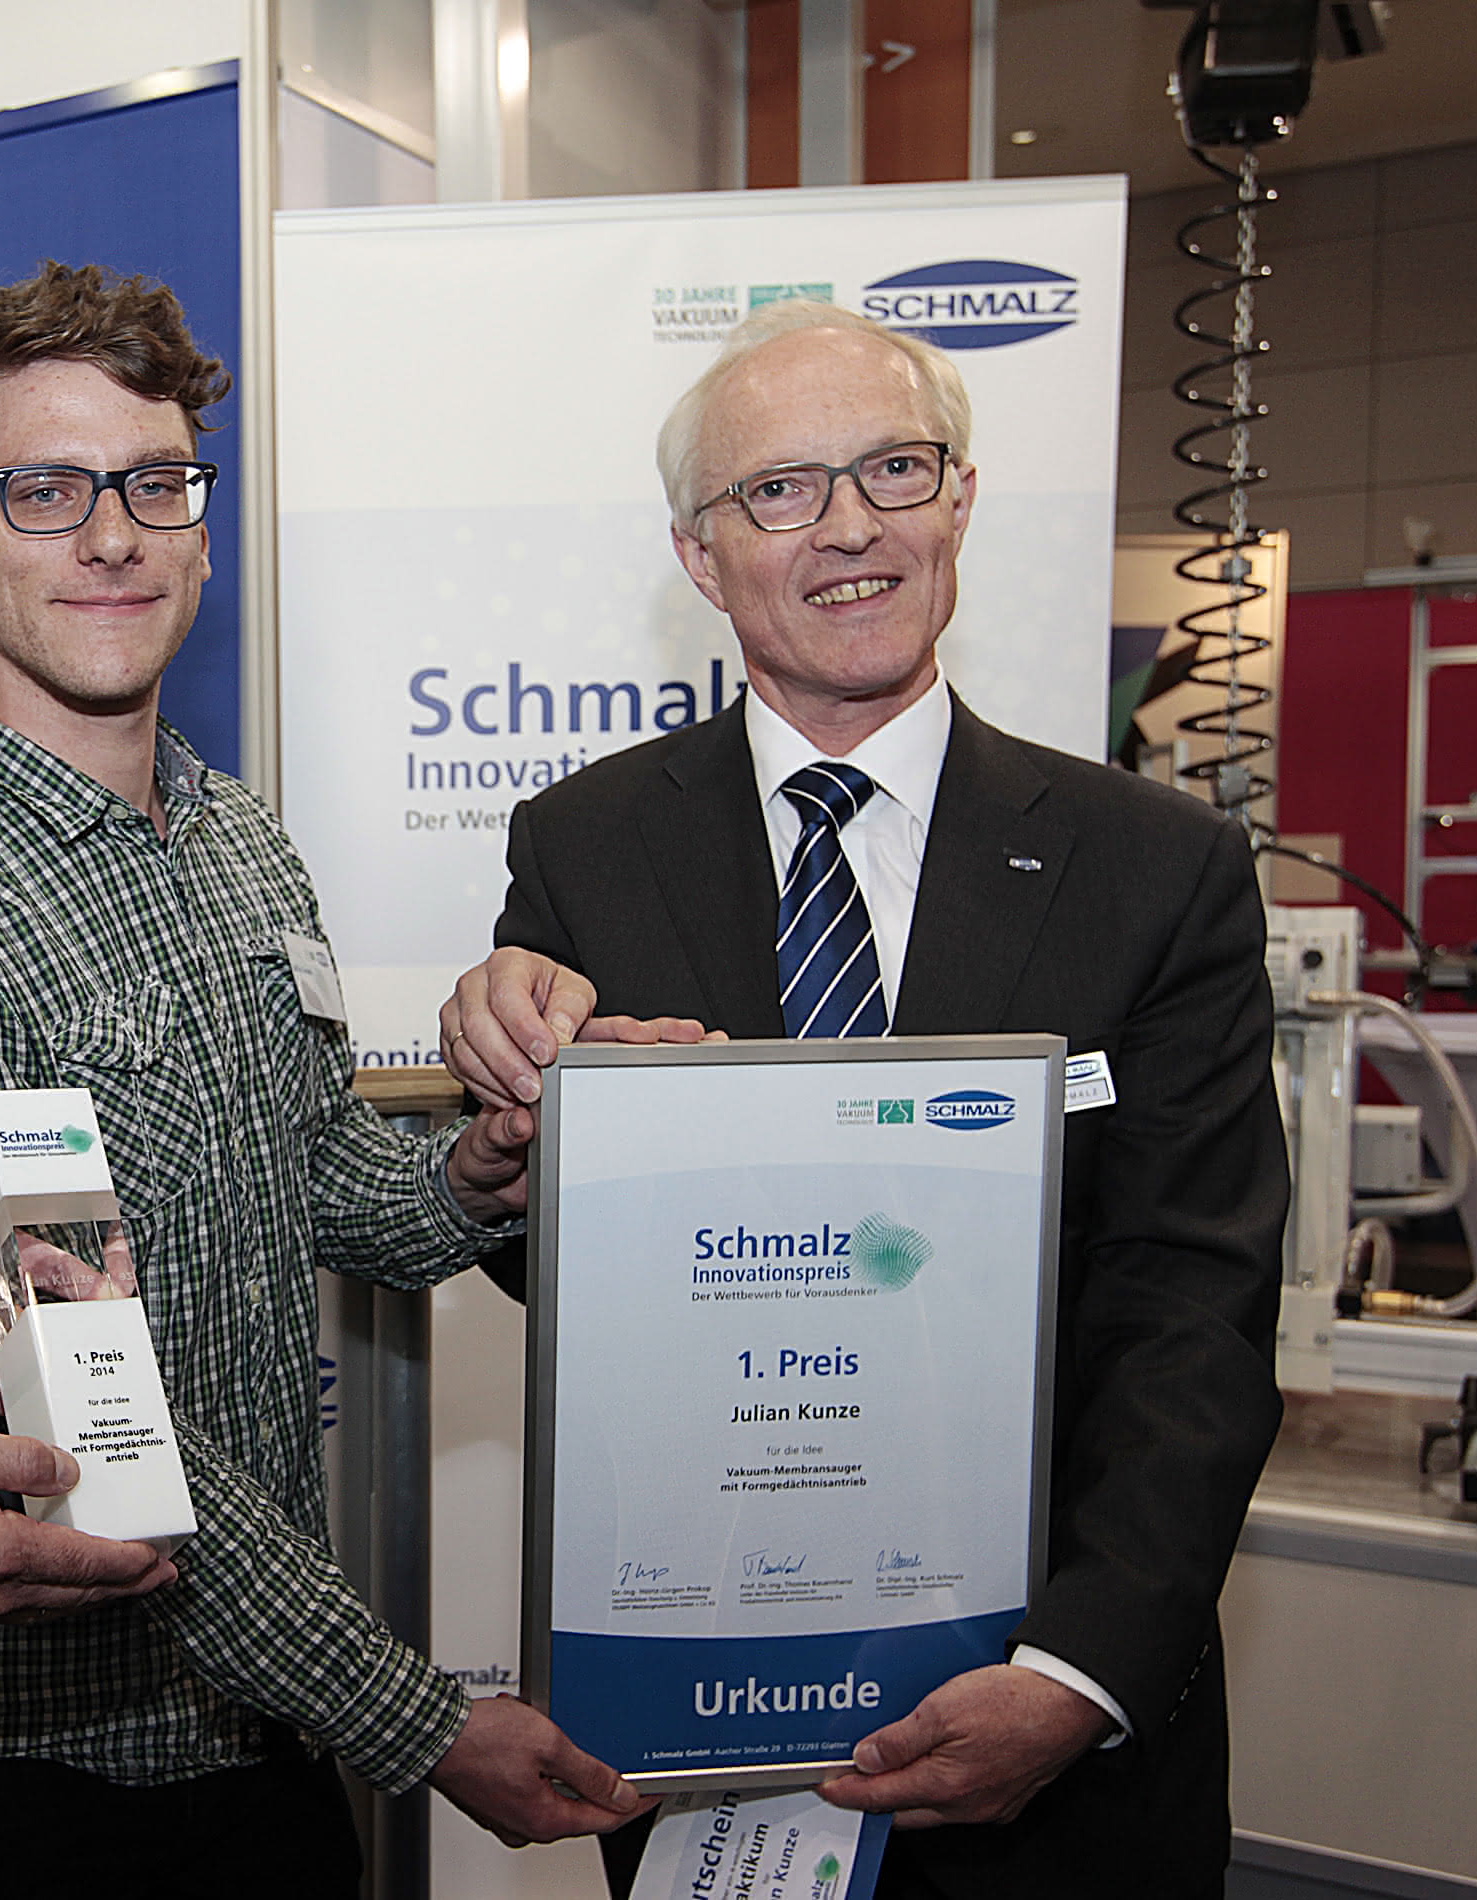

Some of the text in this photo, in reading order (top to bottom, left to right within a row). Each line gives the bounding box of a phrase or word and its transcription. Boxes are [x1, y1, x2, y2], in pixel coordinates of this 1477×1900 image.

[863, 288, 1078, 320] SCHMALZ
[652, 307, 739, 326] VAKUUM
[409, 659, 748, 736] Schmal
[408, 748, 587, 790] Innovati
[405, 810, 508, 830] Der Wet
[837, 1109, 874, 1118] VAKUUM
[925, 1103, 1015, 1118] SCHMALZ
[0, 1129, 62, 1143] Schmalz
[1, 1142, 65, 1151] Innovationspreis
[695, 1224, 851, 1260] Schmalz
[692, 1261, 851, 1285] Innovationspreis
[691, 1286, 878, 1302] Der Wettbewerb für Vorausdenker
[74, 1350, 124, 1365] 1. Preis
[738, 1346, 859, 1379] 1. Preis
[90, 1367, 115, 1377] 2014
[731, 1403, 861, 1423] Julian Kunze
[91, 1418, 133, 1428] Vakuum-
[78, 1428, 155, 1441] Membransauger
[72, 1438, 167, 1454] mit Formgedächtnis-
[766, 1444, 824, 1456] für die Idee
[105, 1452, 140, 1463] antrieb
[726, 1464, 862, 1478] Vakuum-Membransauger
[720, 1477, 867, 1493] mit Formgedächtnisantrieb
[694, 1672, 881, 1717] Urkunde
[651, 1750, 683, 1760] Schmalz
[691, 1791, 741, 1900] tschein
[734, 1823, 770, 1900] aktikum
[772, 1827, 800, 1882] Kunze
